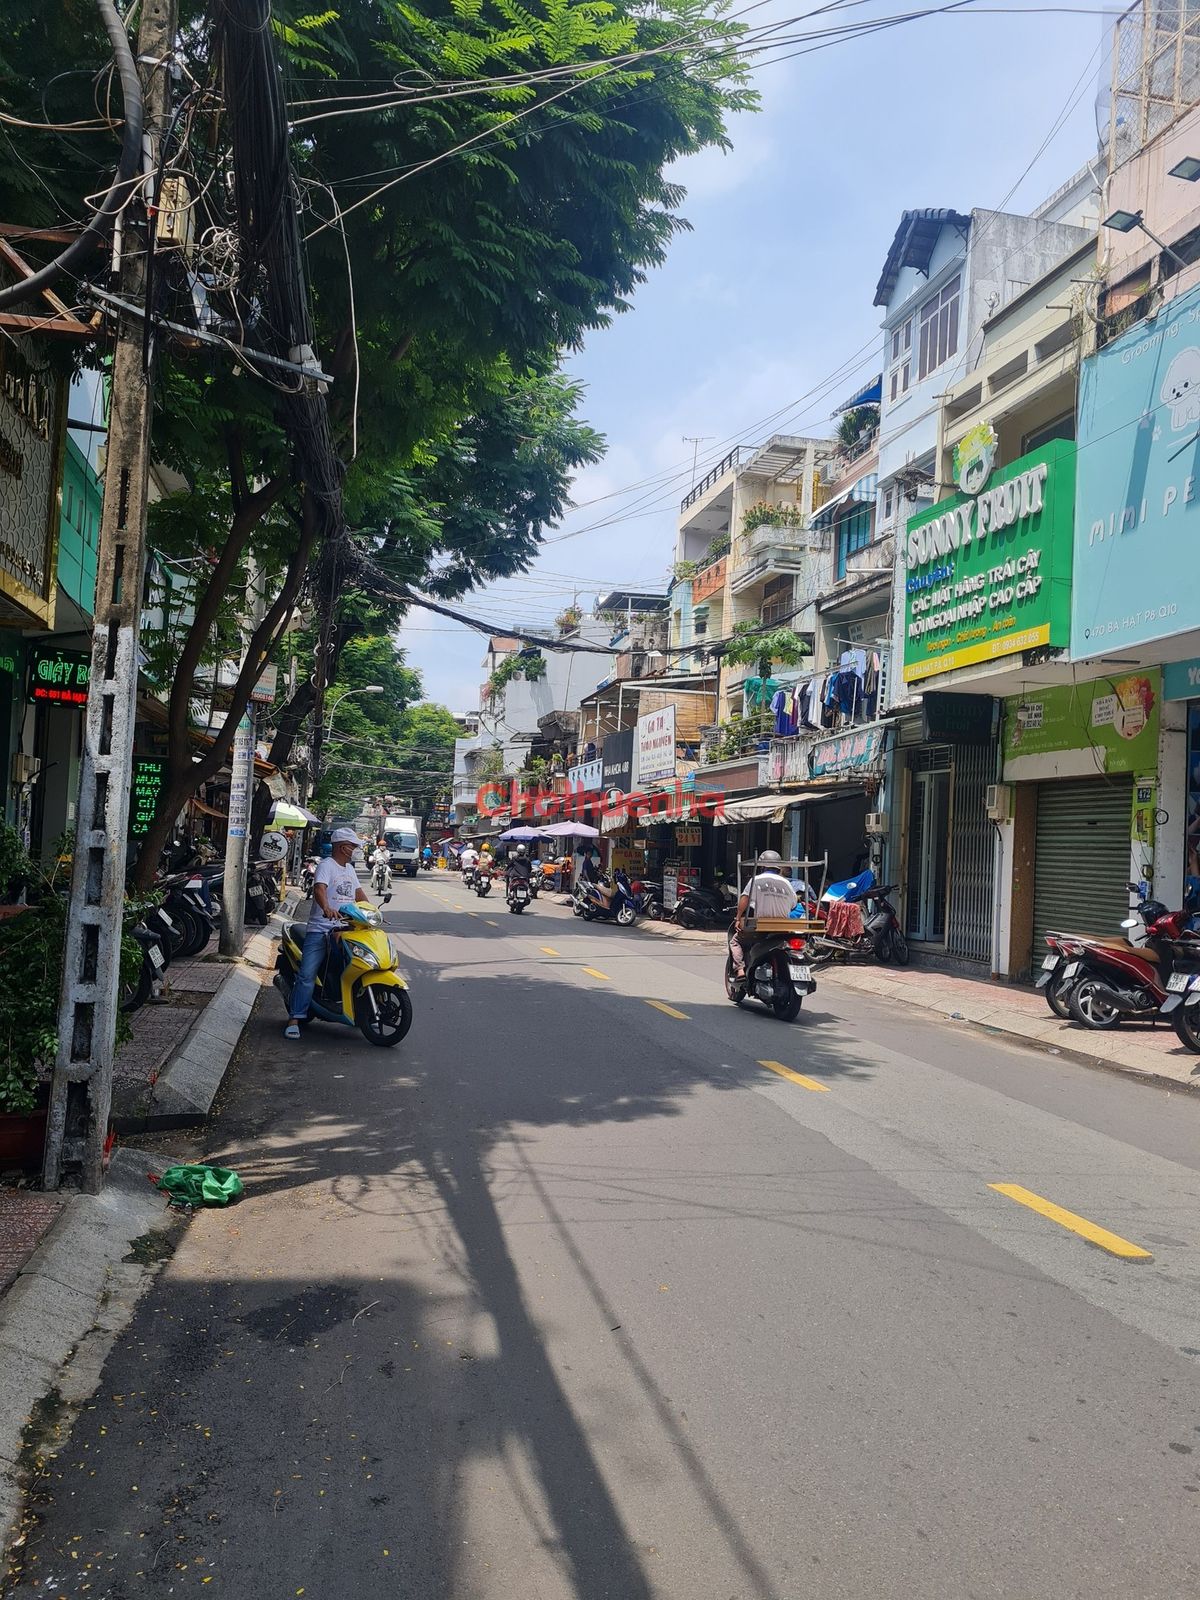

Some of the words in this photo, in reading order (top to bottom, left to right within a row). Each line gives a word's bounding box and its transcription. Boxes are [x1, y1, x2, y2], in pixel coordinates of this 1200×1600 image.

[1121, 321, 1180, 366] Grooming
[907, 499, 975, 569] SUNNY
[976, 463, 1047, 538] FRUIT
[1089, 498, 1147, 547] MIMI
[911, 593, 931, 614] CÁC
[931, 585, 953, 608] MẶT
[954, 573, 985, 598] HÀNG
[987, 556, 1015, 584] TRÁI
[1016, 548, 1042, 573] CÂY
[908, 617, 927, 638] NỘI
[927, 607, 957, 627] NGOẠI
[957, 594, 987, 618] NHẬP
[988, 587, 1014, 609] CAO
[1016, 570, 1042, 599] CẤP
[1159, 603, 1178, 618] Q10
[38, 657, 73, 685] GIÀY
[136, 775, 161, 785] MUA
[137, 762, 161, 772] THU
[1138, 788, 1151, 799] 472
